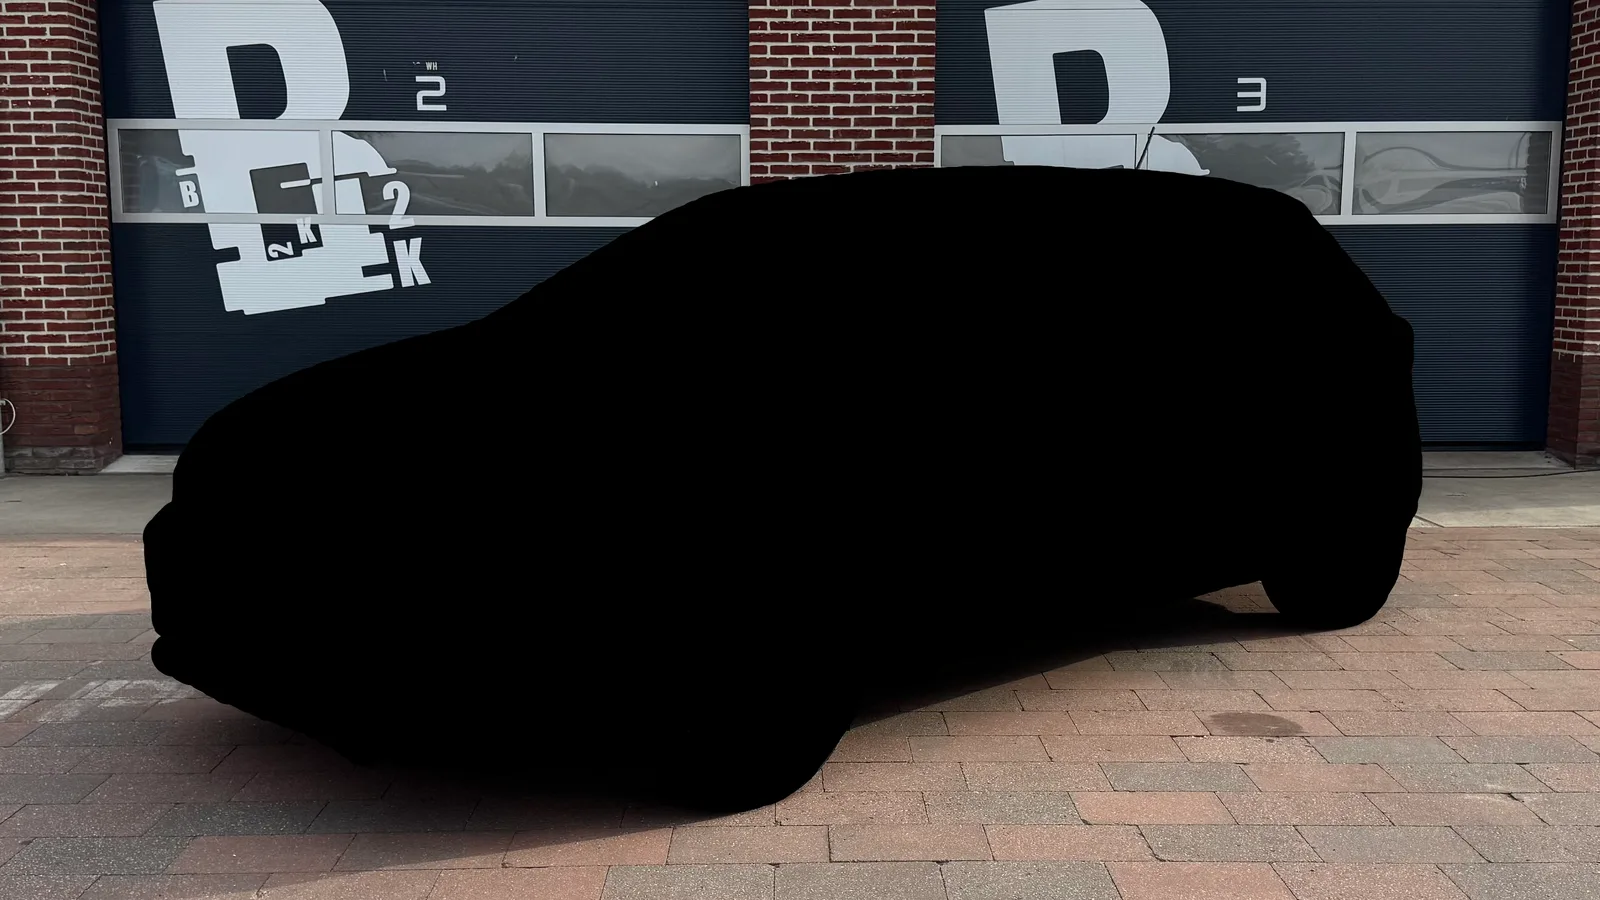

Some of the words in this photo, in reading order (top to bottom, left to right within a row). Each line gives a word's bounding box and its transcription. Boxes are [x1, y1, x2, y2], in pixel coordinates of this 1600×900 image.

[425, 61, 438, 71] WH
[415, 75, 447, 111] 2
[1236, 77, 1267, 112] 3
[179, 180, 200, 208] B
[382, 180, 415, 230] 2
[296, 216, 318, 244] K
[393, 237, 432, 288] K
